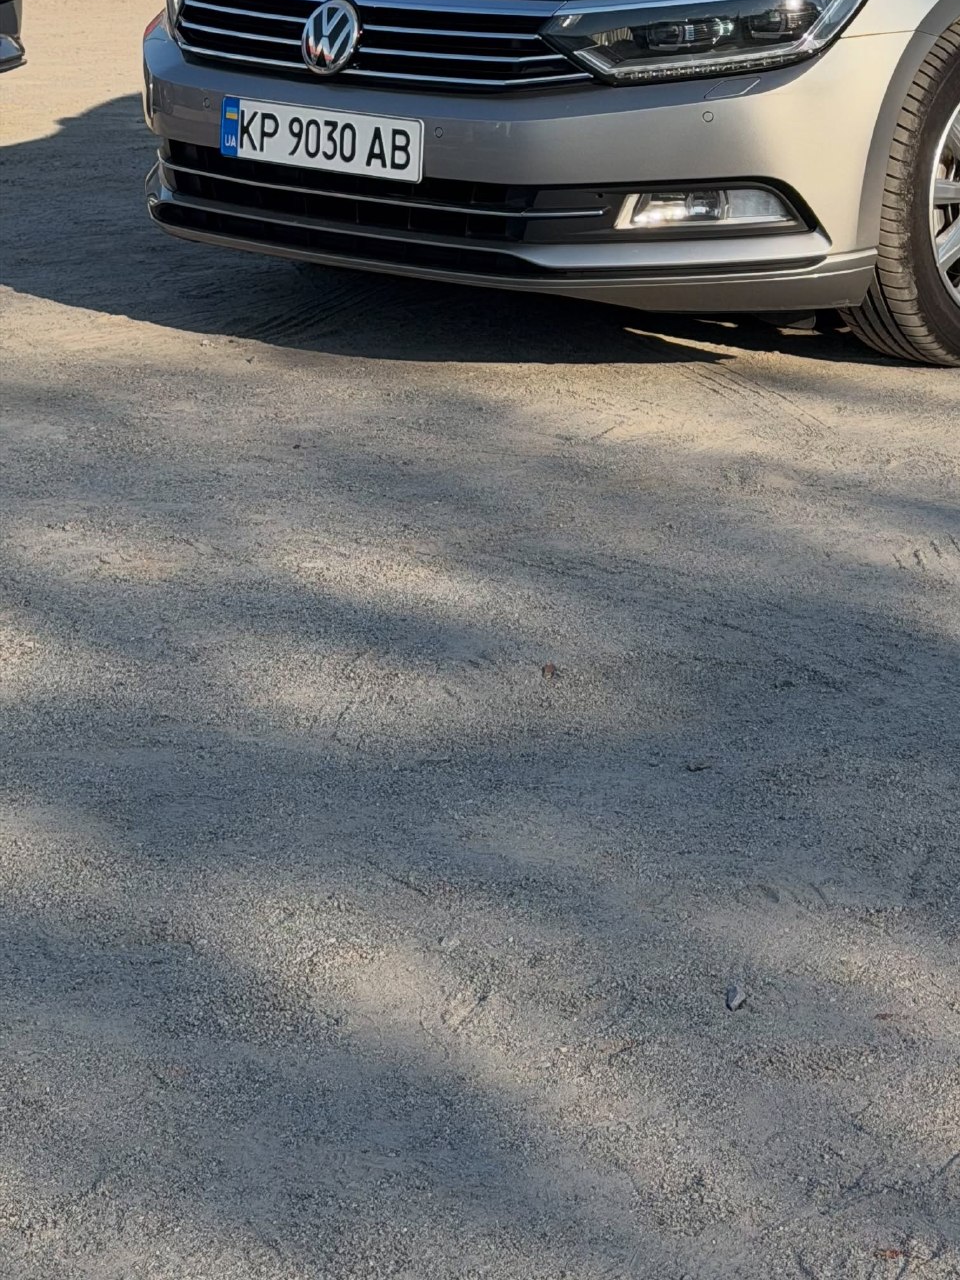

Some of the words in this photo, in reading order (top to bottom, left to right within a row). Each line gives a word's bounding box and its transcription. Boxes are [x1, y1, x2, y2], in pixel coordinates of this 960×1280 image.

[224, 134, 237, 148] UA
[240, 109, 280, 153] KP
[288, 116, 357, 163] 9030
[365, 126, 411, 170] AB
